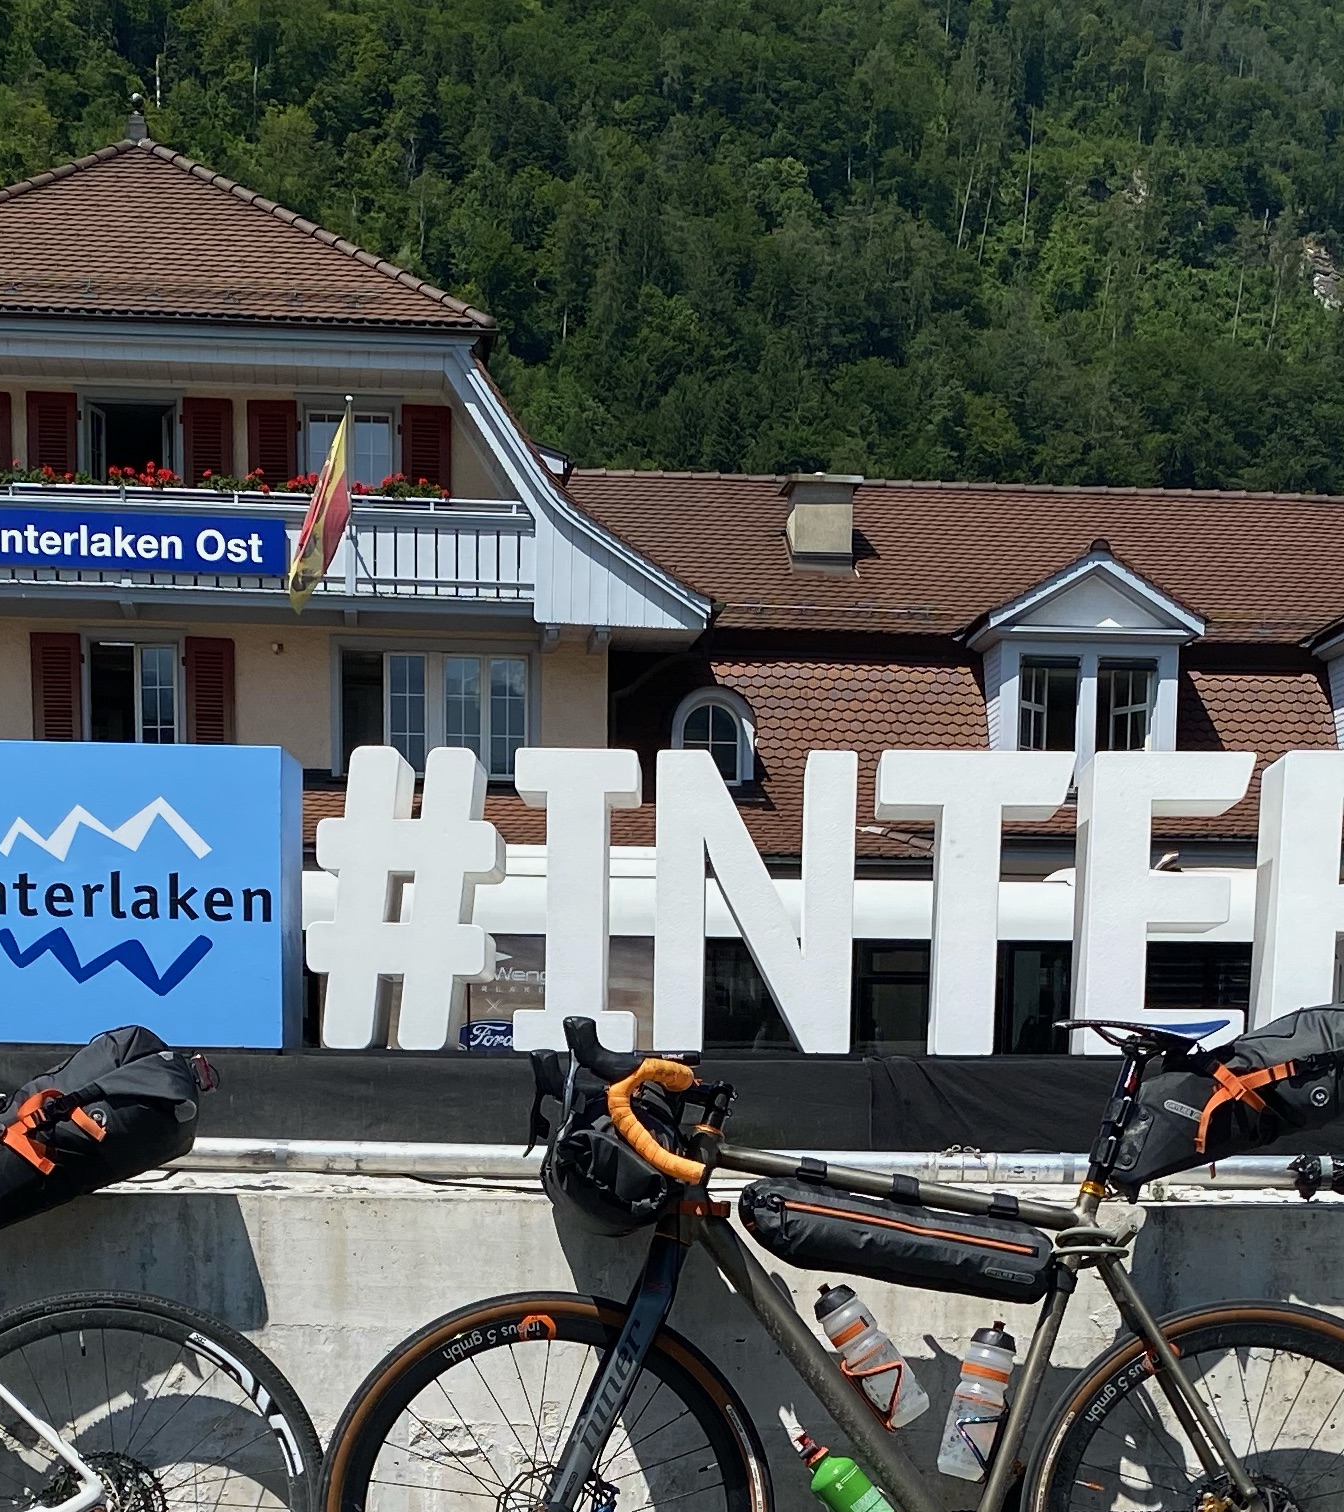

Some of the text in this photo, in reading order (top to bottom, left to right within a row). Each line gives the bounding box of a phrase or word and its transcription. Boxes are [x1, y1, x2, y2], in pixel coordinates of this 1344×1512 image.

[196, 528, 263, 563] Ost
[442, 1330, 483, 1362] gmbh
[1084, 1383, 1117, 1423] gmbh
